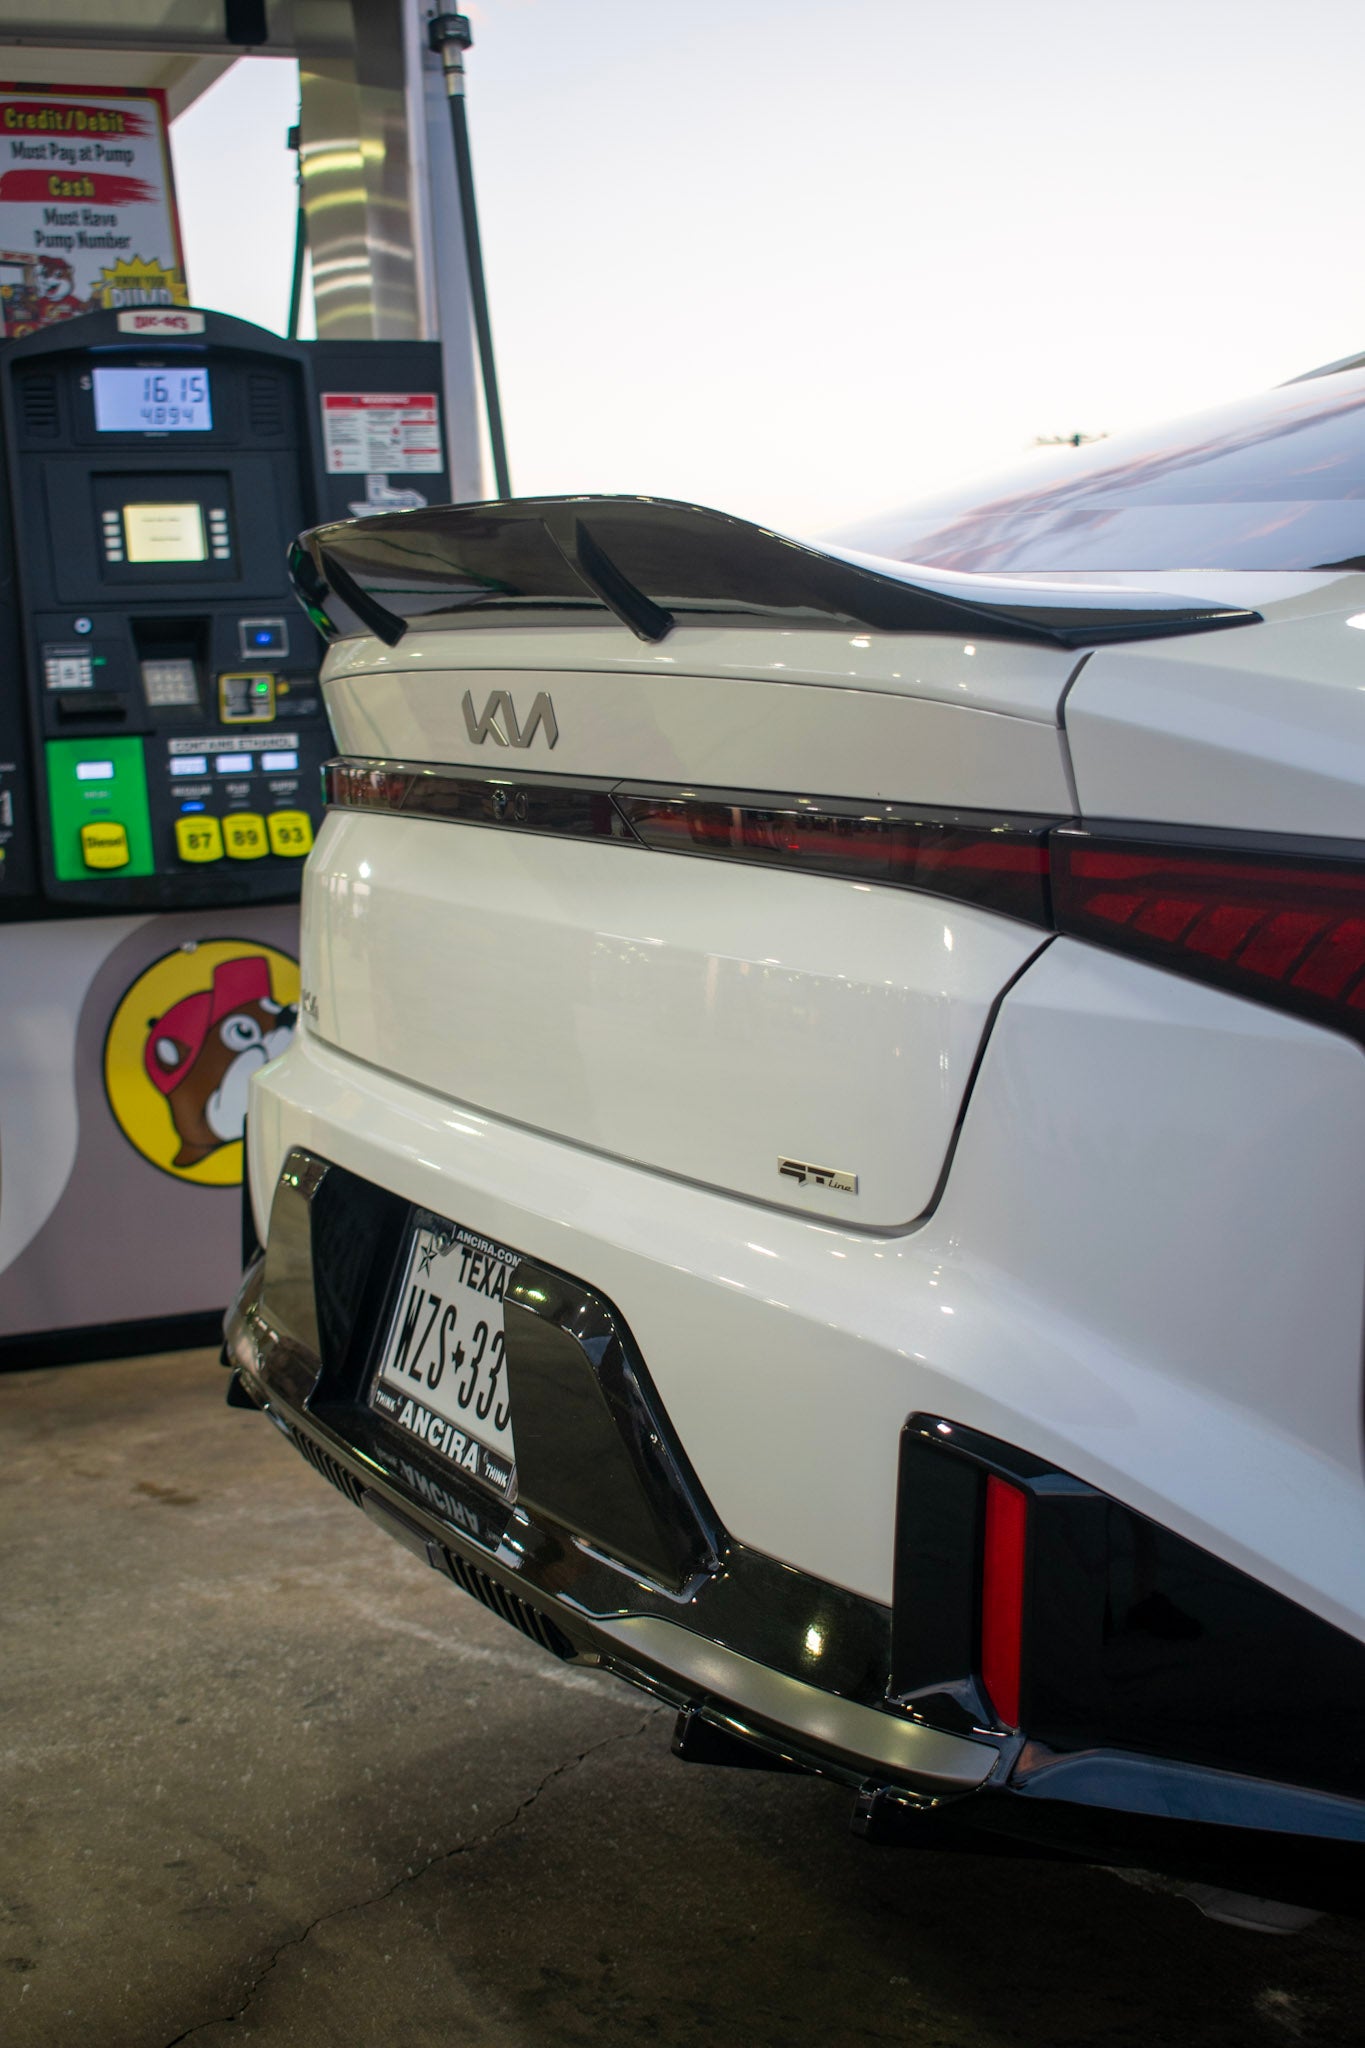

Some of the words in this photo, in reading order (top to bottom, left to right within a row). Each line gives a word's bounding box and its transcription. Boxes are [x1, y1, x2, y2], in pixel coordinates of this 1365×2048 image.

[4, 107, 125, 133] Credit/Debit
[11, 141, 46, 160] Must
[49, 142, 76, 165] Pay
[79, 147, 92, 162] at
[94, 144, 135, 167] Pump
[48, 175, 95, 197] Cash
[43, 208, 79, 227] Must
[81, 209, 118, 227] Have
[34, 229, 74, 253] Pump
[76, 231, 132, 249] Number
[187, 832, 212, 850] 87
[233, 829, 258, 846] 89
[278, 827, 303, 844] 93
[458, 1246, 508, 1303] TEXA
[393, 1285, 457, 1390] WZS
[375, 1389, 397, 1413] THINK
[397, 1400, 480, 1474] ANCIRA
[484, 1462, 509, 1489] THINK
